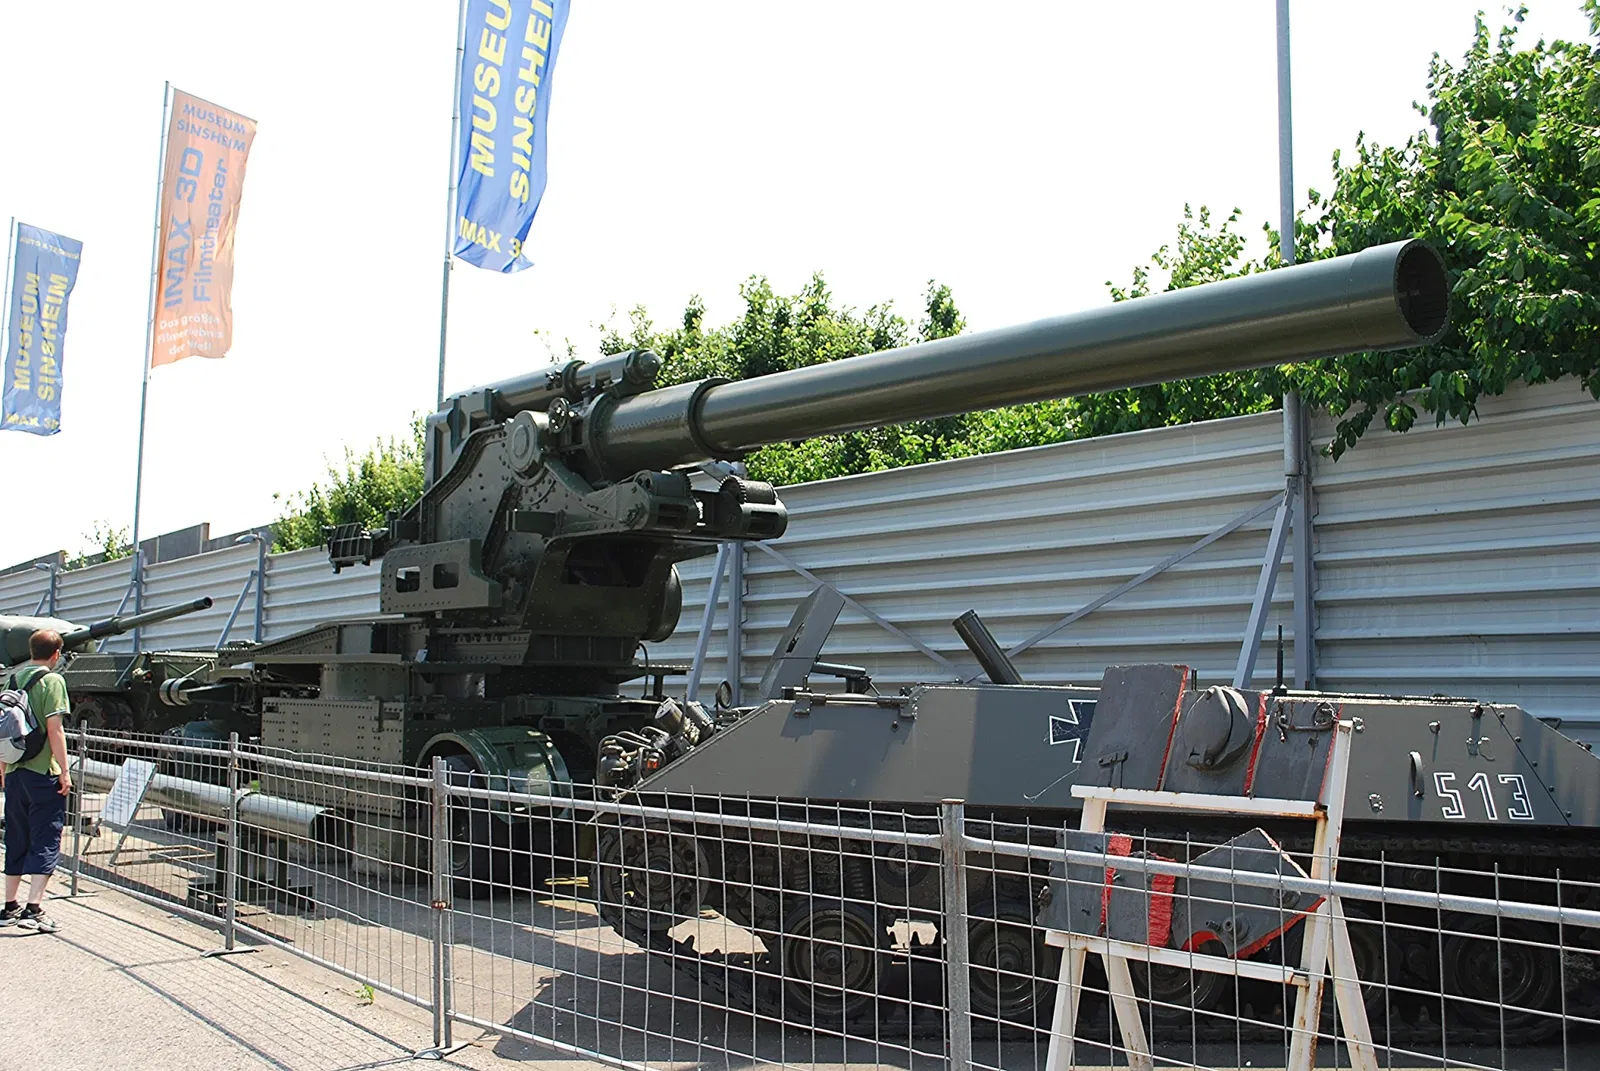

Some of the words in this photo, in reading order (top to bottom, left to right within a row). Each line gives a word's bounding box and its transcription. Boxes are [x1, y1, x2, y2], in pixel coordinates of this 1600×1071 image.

[176, 119, 247, 152] SINSHEIM
[182, 103, 246, 135] MUSEUM
[175, 146, 204, 203] 3D
[193, 158, 228, 302] Filmtheater
[459, 215, 502, 254] IMAX
[164, 215, 192, 309] IMAX
[13, 271, 40, 391] MUSEUM
[37, 272, 69, 402] SINSHEIM
[1433, 772, 1535, 821] 513
